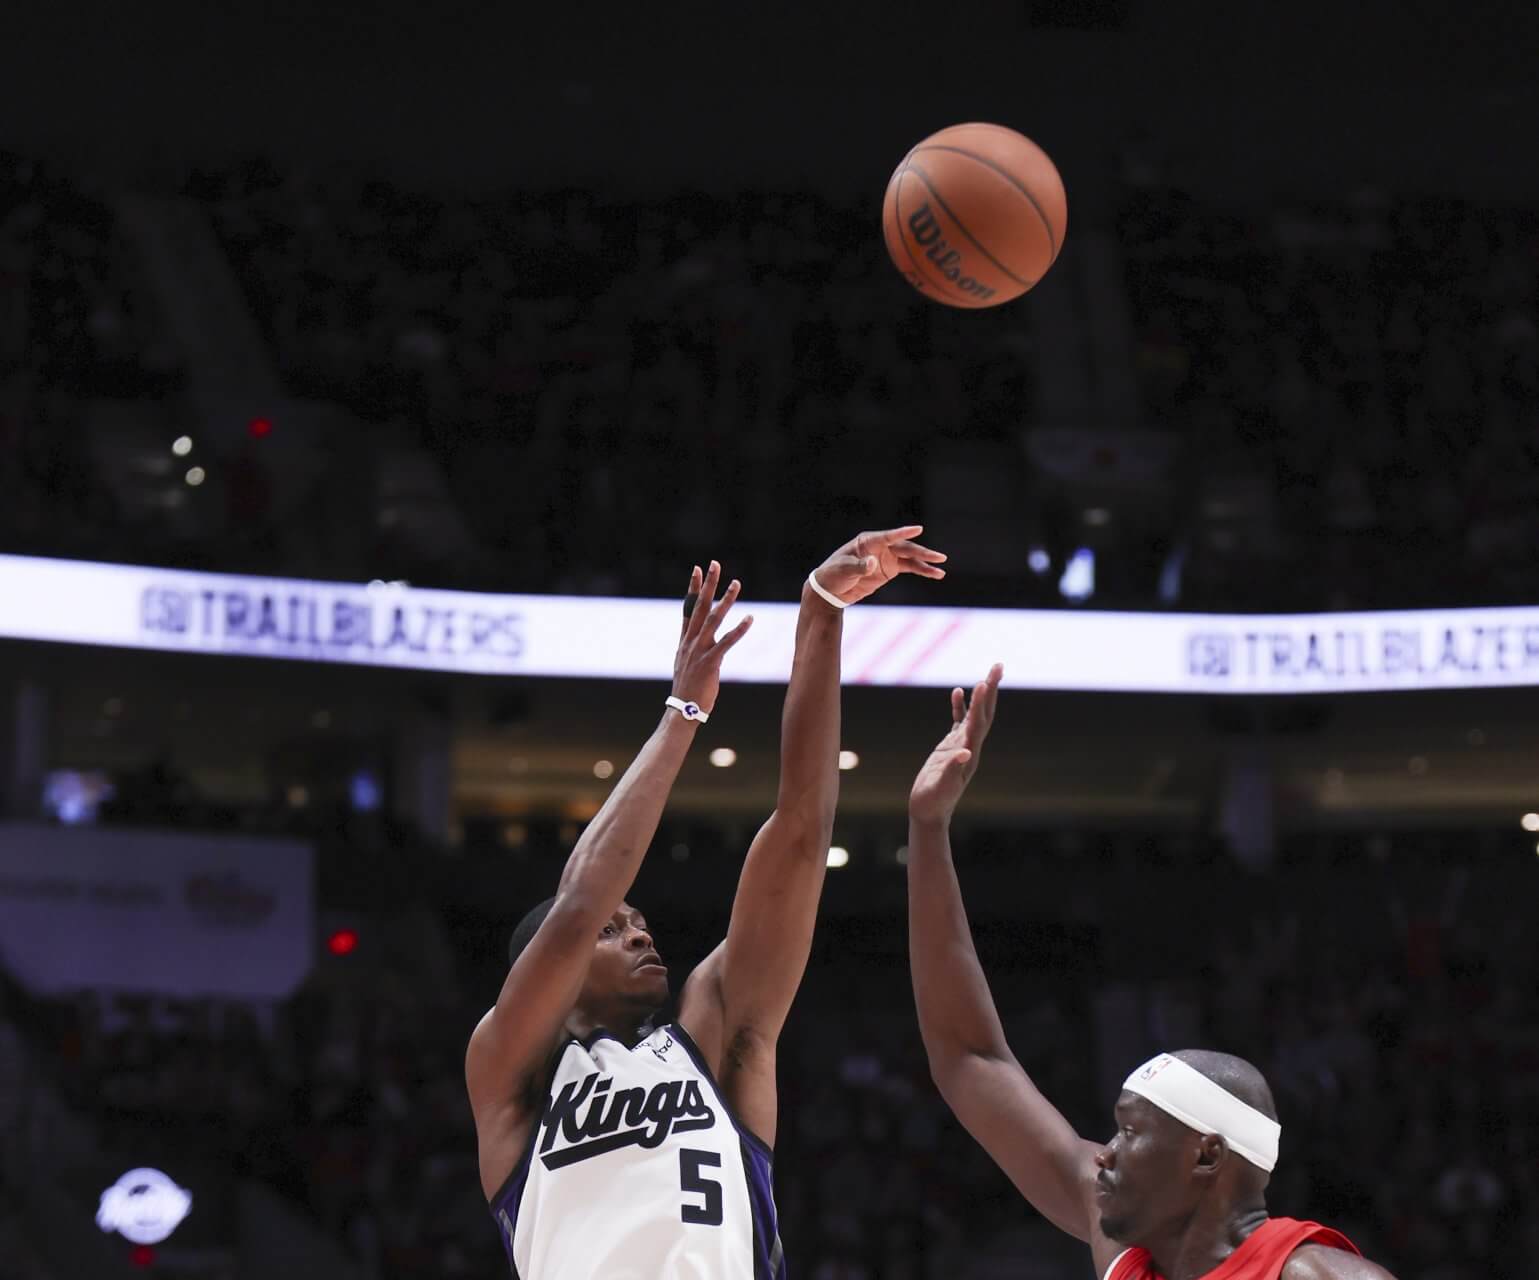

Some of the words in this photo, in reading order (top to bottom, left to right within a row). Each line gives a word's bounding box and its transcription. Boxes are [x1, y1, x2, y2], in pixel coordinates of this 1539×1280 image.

[908, 202, 996, 299] Wilson
[538, 1072, 716, 1171] Kings
[679, 1147, 724, 1227] 5
